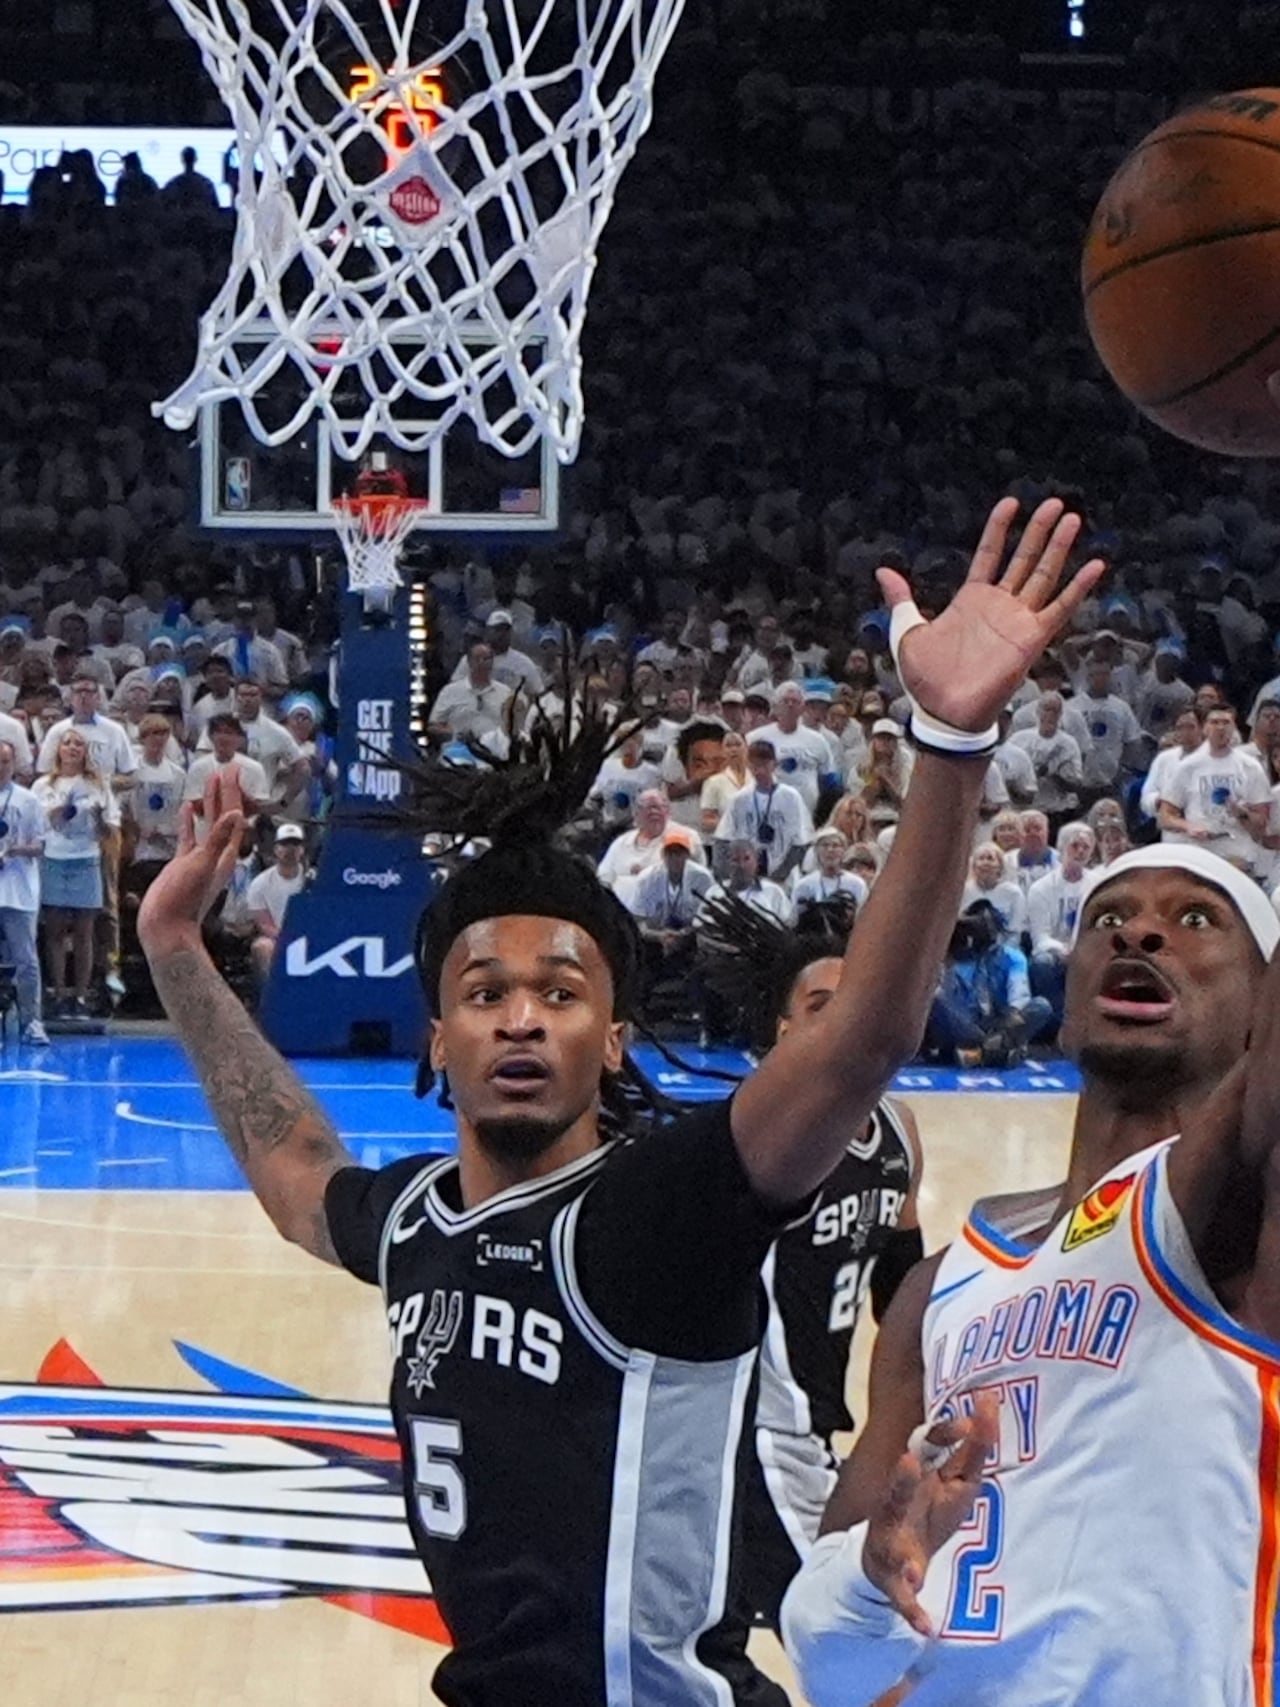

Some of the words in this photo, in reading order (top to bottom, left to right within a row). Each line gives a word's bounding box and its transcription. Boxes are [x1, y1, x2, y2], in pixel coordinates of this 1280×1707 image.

[357, 700, 394, 731] GET
[357, 732, 393, 762] THE
[365, 769, 401, 801] App
[343, 867, 401, 890] Google
[485, 1243, 534, 1262] LEDGER
[930, 1279, 1139, 1396] LAHOMA
[408, 1413, 468, 1541] 5
[940, 1473, 1006, 1642] 2
